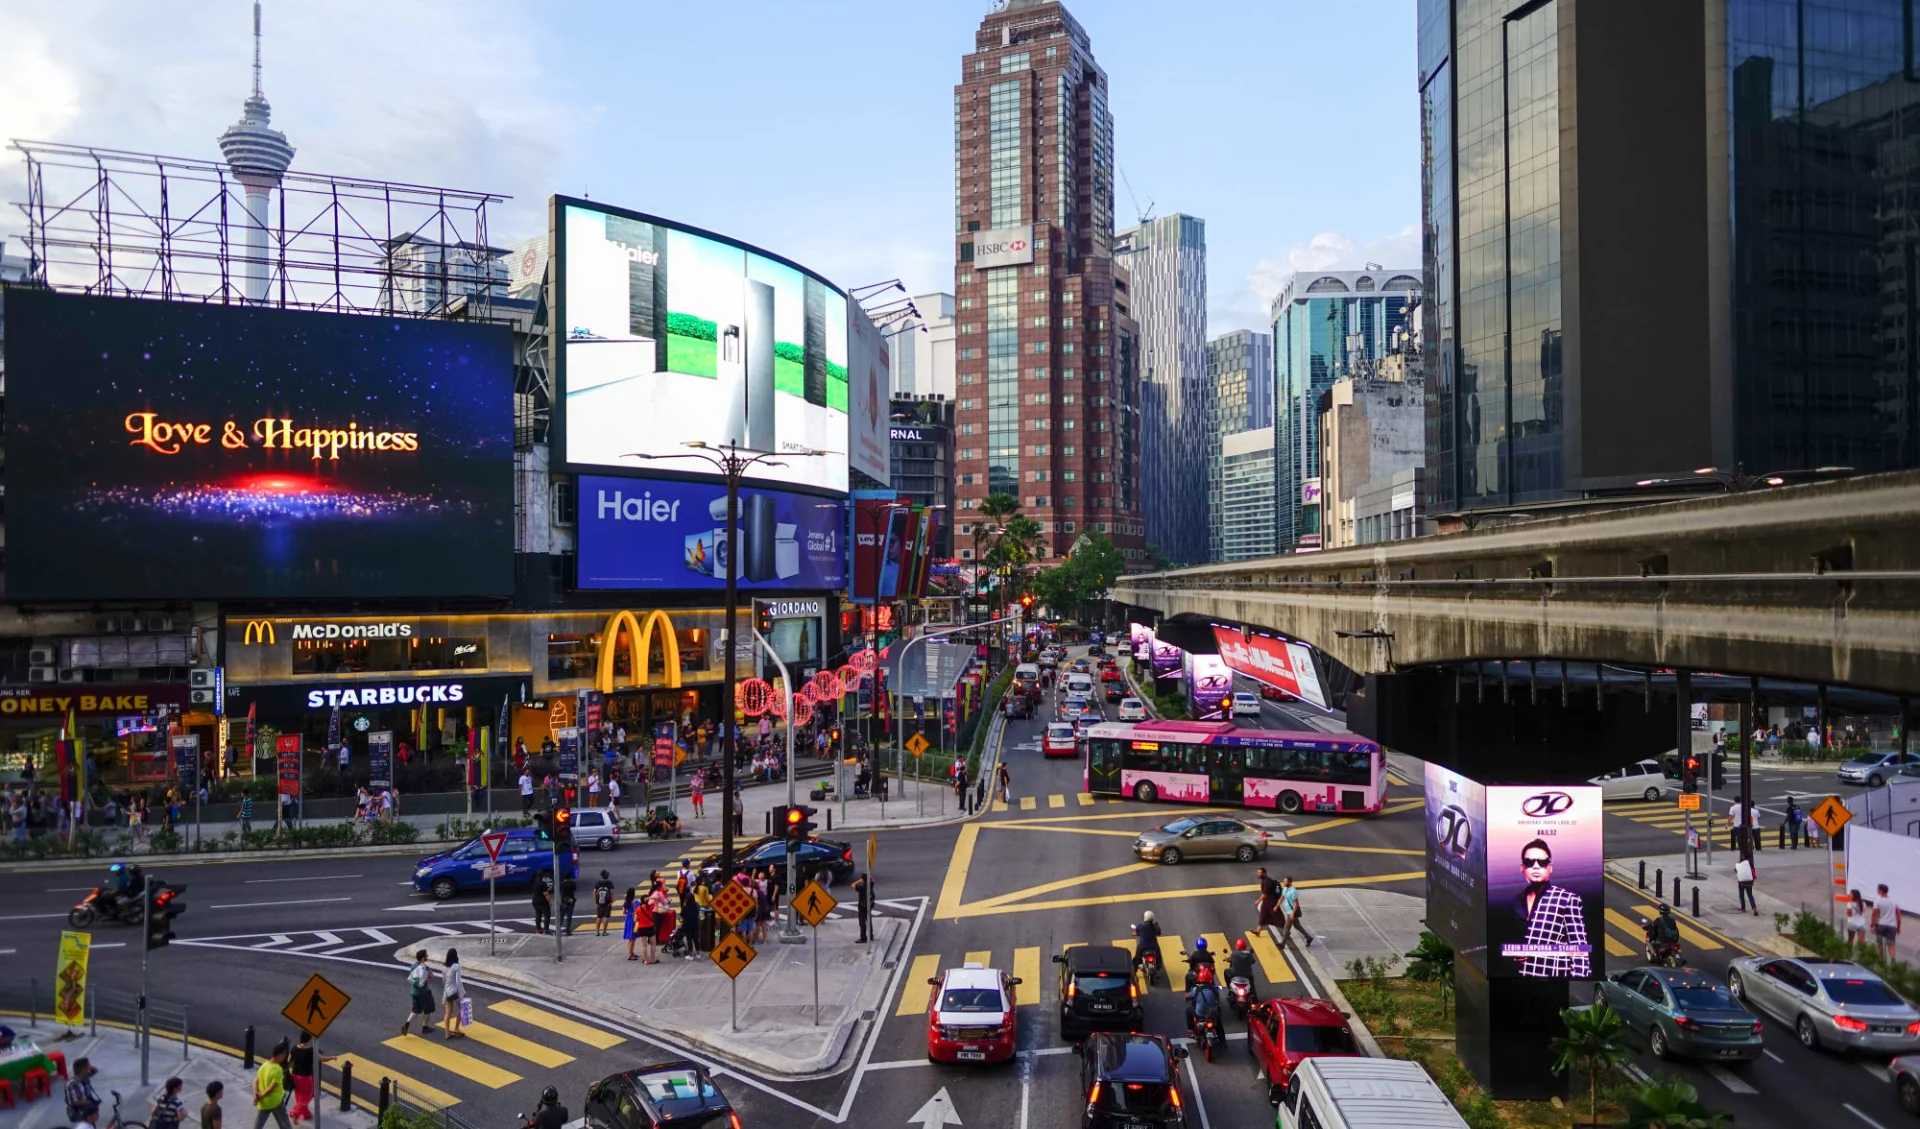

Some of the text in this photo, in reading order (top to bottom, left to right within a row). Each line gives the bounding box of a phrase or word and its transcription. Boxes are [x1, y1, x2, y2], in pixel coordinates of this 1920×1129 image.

[977, 242, 1008, 256] HSBC
[125, 412, 418, 460] Love & Happiness
[891, 429, 922, 440] RNAL
[598, 490, 680, 522] Haier
[807, 529, 824, 540] Jenama
[807, 540, 824, 552] Global
[770, 601, 818, 616] GIORDANO
[293, 623, 411, 639] McDonald's
[228, 687, 241, 696] KAFE
[307, 684, 463, 708] STARBUCKS
[1, 697, 72, 713] ONEY
[80, 695, 148, 711] BAKE
[1504, 944, 1521, 952] LEBIH
[1522, 944, 1552, 952] SEMPURNA
[1558, 944, 1580, 952] SYAMEL
